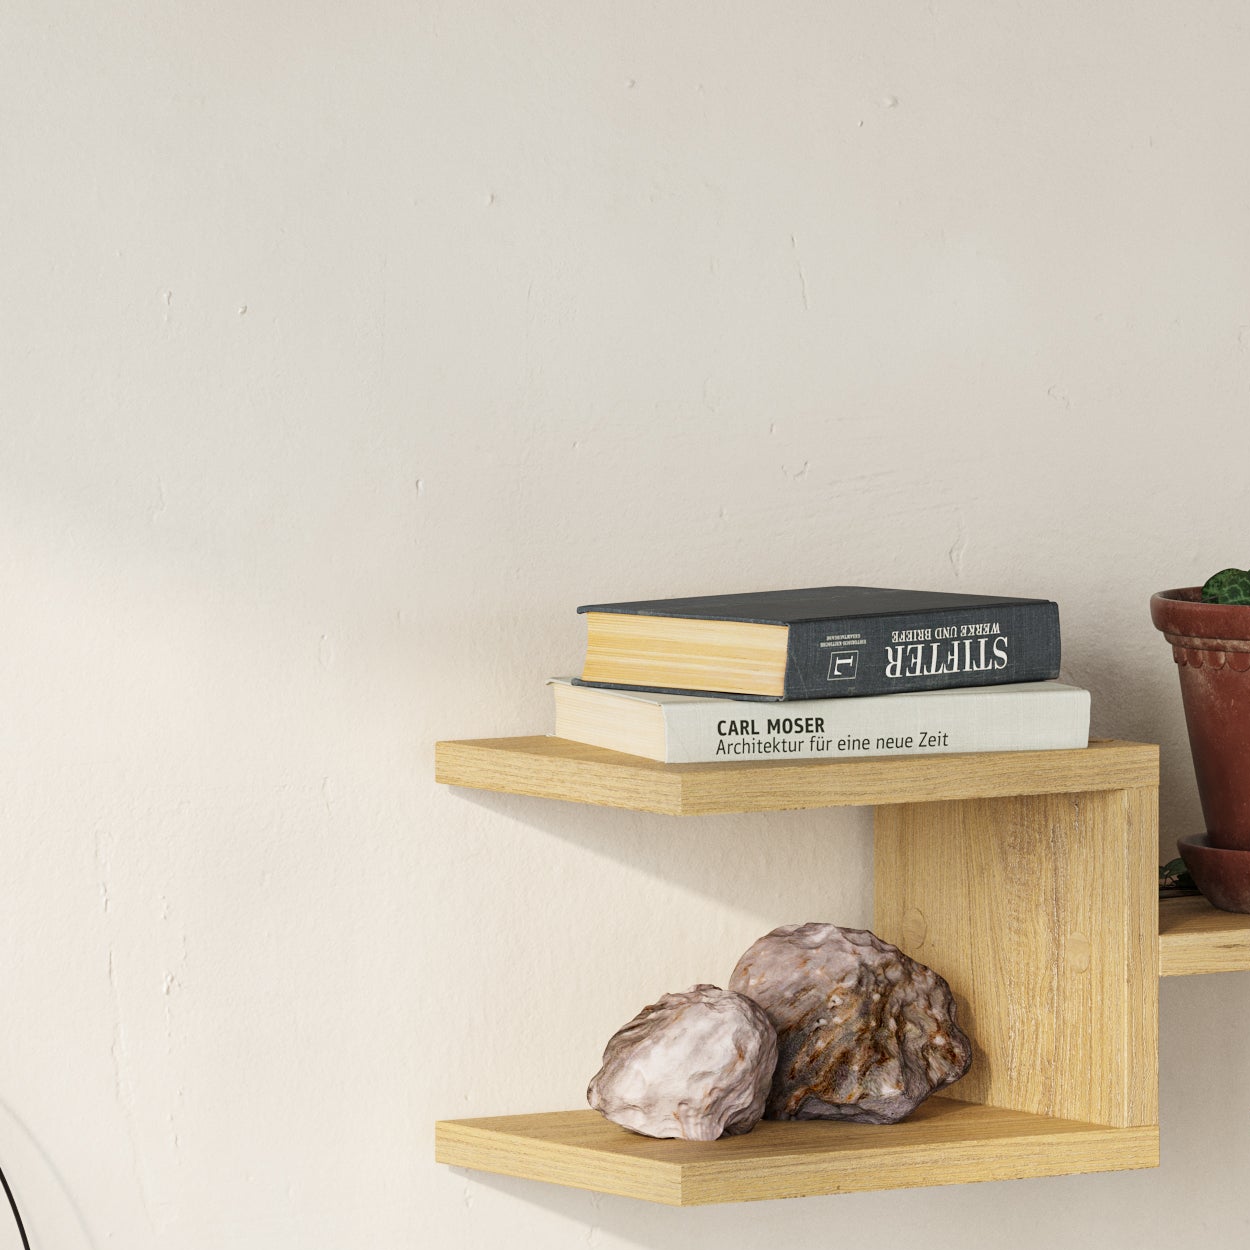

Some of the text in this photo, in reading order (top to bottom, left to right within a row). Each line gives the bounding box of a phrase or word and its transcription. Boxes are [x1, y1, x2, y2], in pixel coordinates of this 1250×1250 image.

[892, 622, 1001, 643] WERKE UND BRIEFE
[885, 636, 1008, 678] STIFTER
[717, 717, 825, 736] CARL MOSER
[716, 731, 949, 755] Architektur für eine neue Zeit
